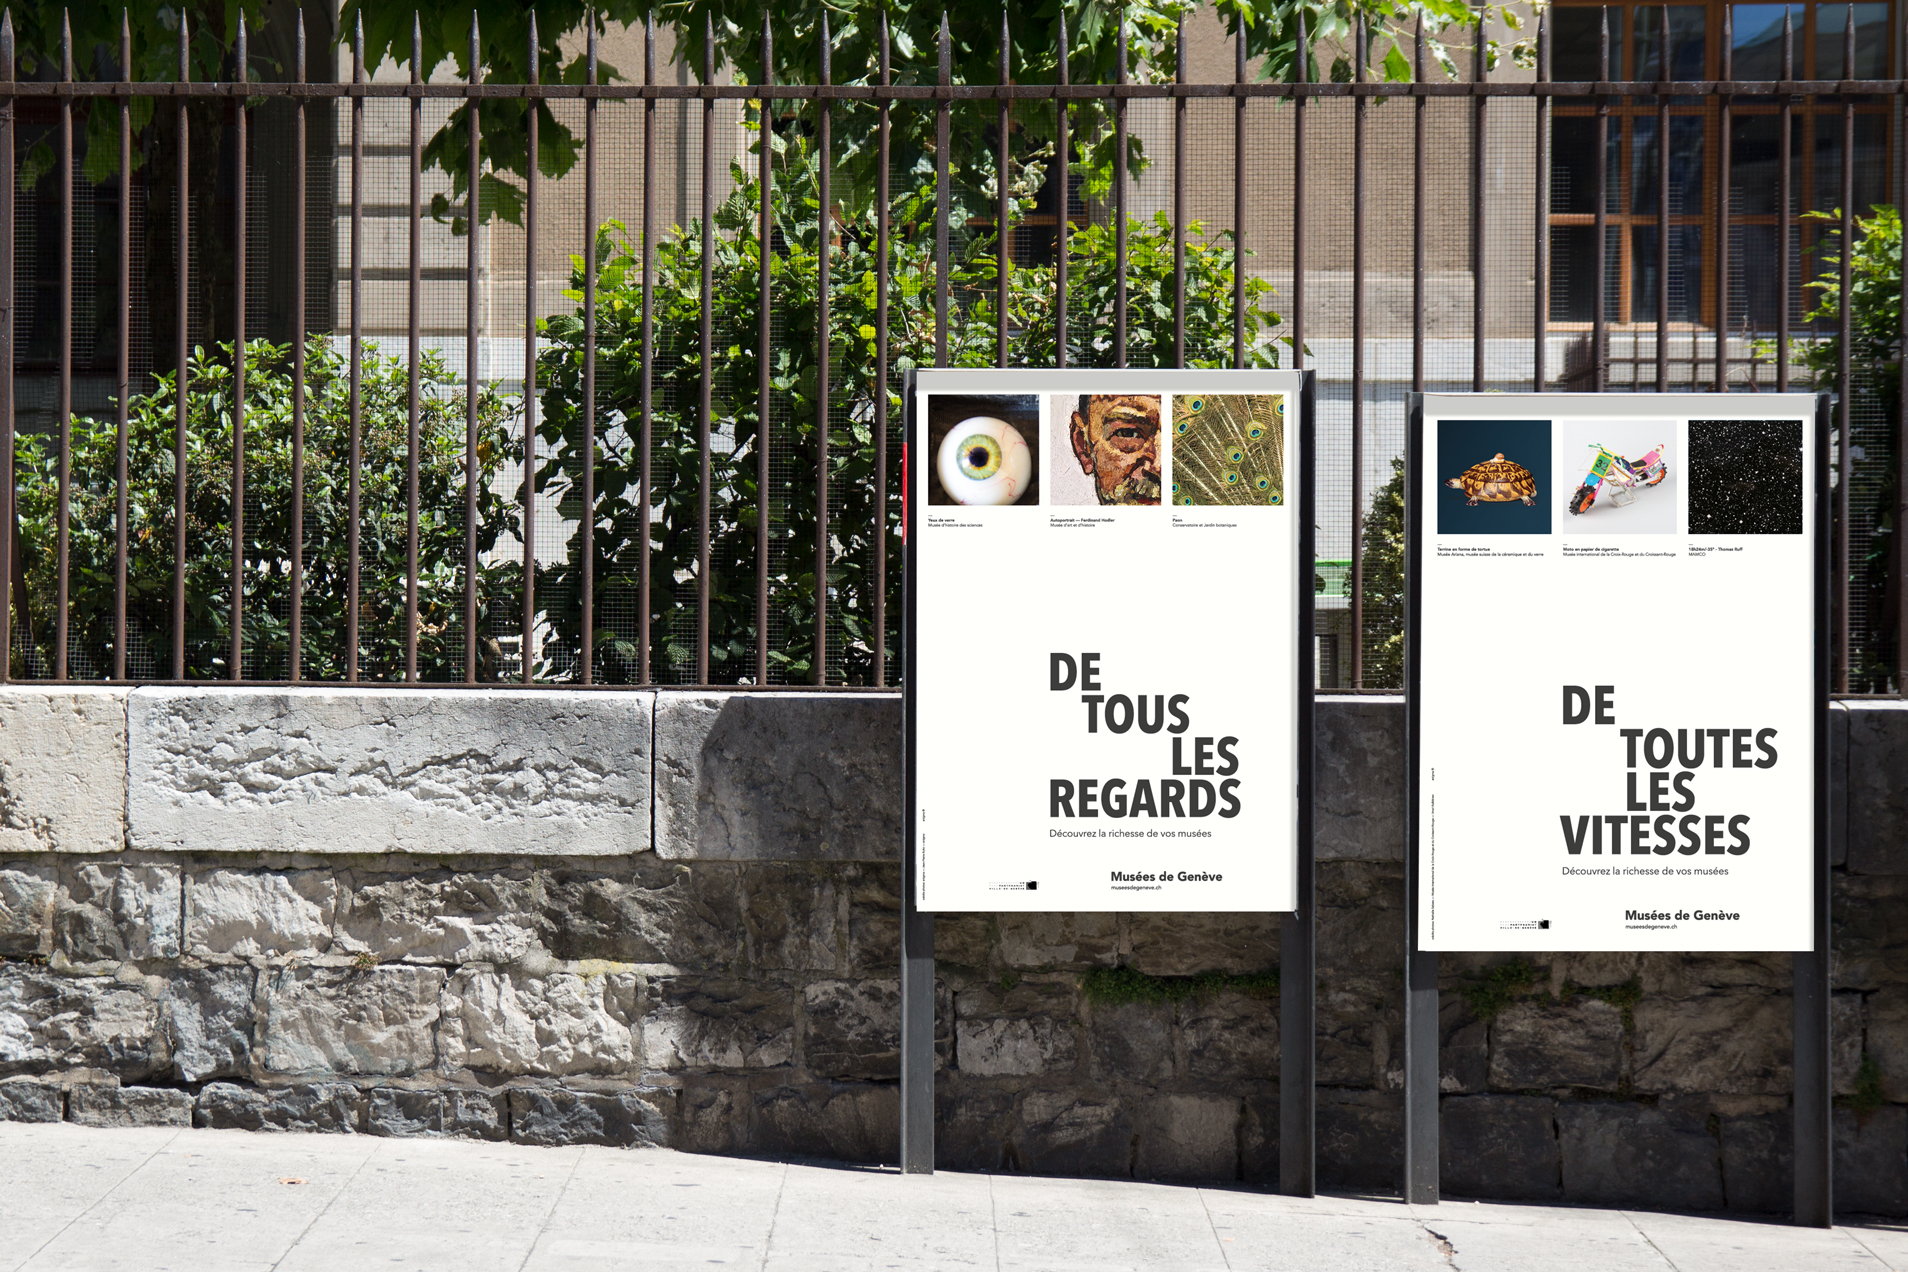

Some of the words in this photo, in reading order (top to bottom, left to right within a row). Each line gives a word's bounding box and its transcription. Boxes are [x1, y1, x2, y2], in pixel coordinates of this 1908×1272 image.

[1596, 459, 1608, 472] 32
[1050, 652, 1101, 691] DE
[1081, 694, 1190, 734] TOUS
[1563, 685, 1615, 725] DE
[1172, 736, 1239, 776] LES
[1620, 728, 1778, 769] TOUTES
[1050, 778, 1241, 818] REGARDS
[1627, 771, 1695, 812] LES
[1050, 829, 1096, 837] Découvrez
[1099, 829, 1106, 837] la
[1109, 829, 1144, 837] richesse
[1146, 829, 1158, 837] de
[1178, 829, 1212, 837] musées
[1559, 814, 1750, 856] VITESSES
[1111, 871, 1156, 882] Musées
[1159, 871, 1174, 882] de
[1177, 871, 1223, 882] Genève
[1562, 867, 1610, 875] Découvrez
[1613, 866, 1620, 875] la
[1623, 866, 1660, 875] richesse
[1662, 866, 1674, 875] de
[1694, 867, 1729, 875] musées
[1625, 910, 1671, 920] Musées
[1674, 909, 1690, 920] de
[1693, 910, 1740, 920] Genève
